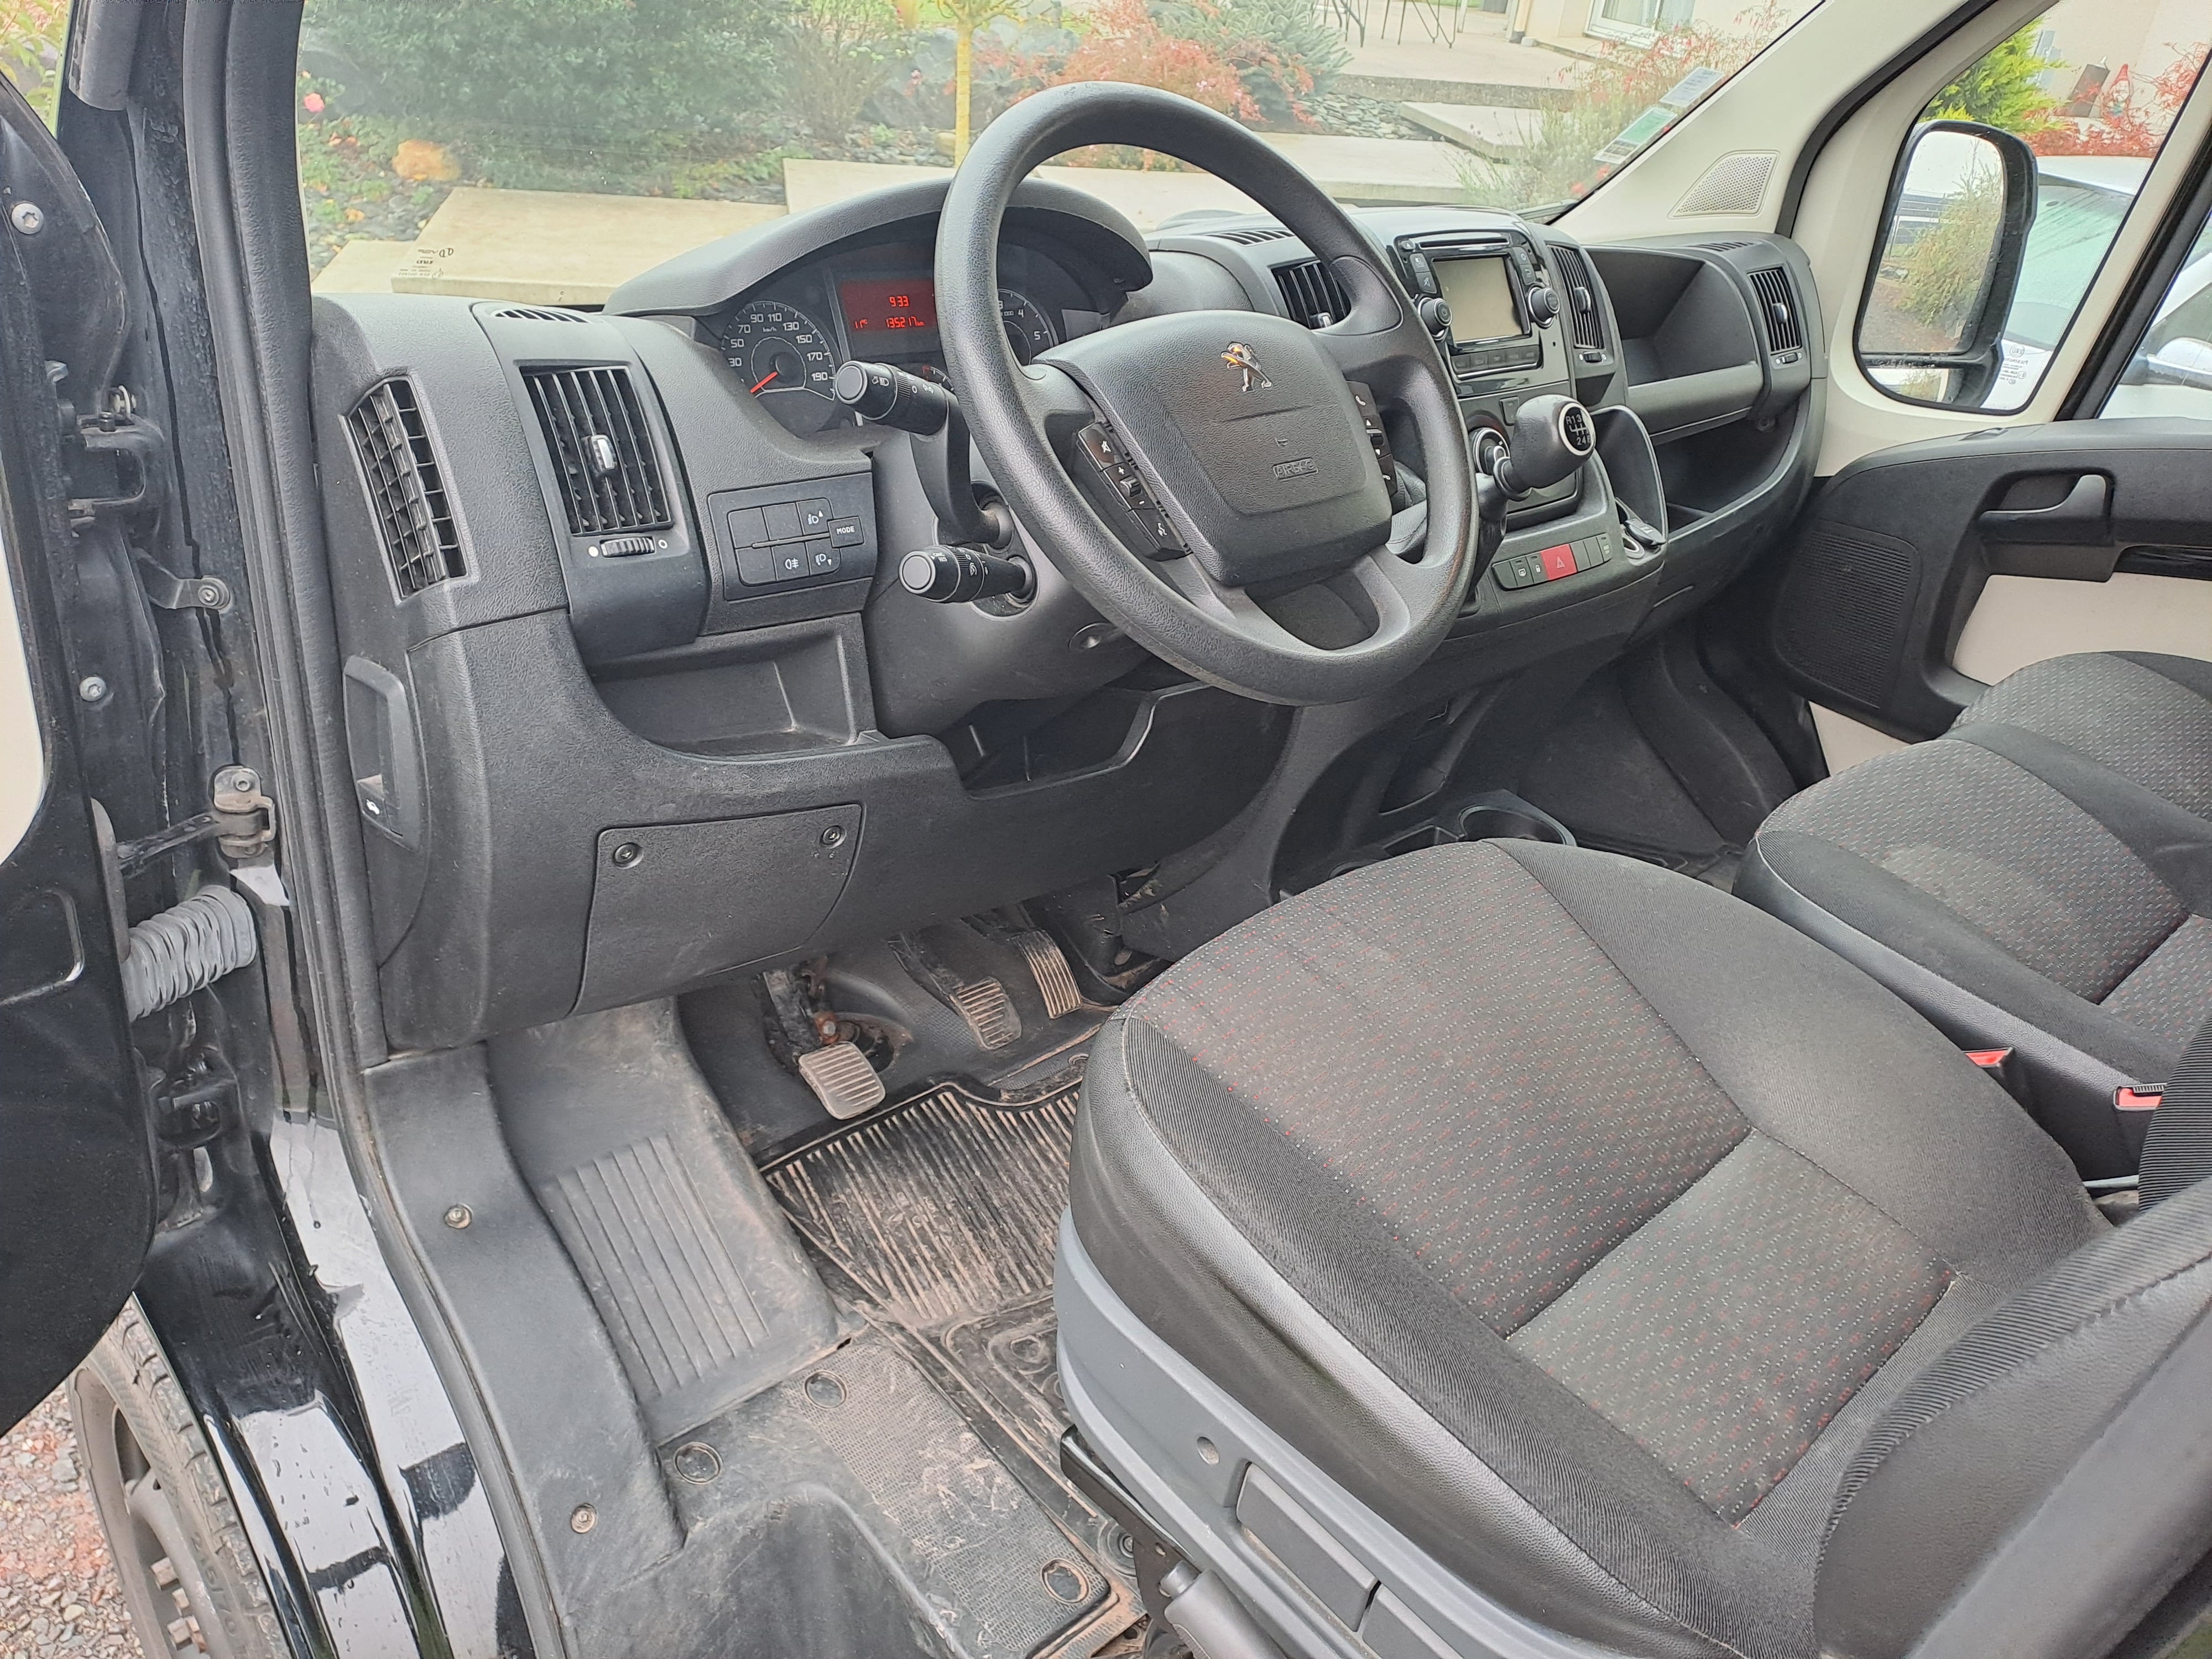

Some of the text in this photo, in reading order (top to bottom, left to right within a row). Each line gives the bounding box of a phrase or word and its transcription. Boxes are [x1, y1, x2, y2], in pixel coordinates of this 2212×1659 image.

[768, 312, 782, 322] 110
[1018, 309, 1024, 318] 4
[750, 314, 764, 323] 90
[738, 325, 751, 334] 70
[782, 321, 800, 331] 130
[796, 334, 812, 343] 150
[1034, 331, 1041, 340] 5
[730, 338, 744, 348] 50
[807, 352, 823, 361] 170
[728, 357, 742, 367] 30
[811, 372, 828, 381] 190
[836, 526, 855, 535] MODE
